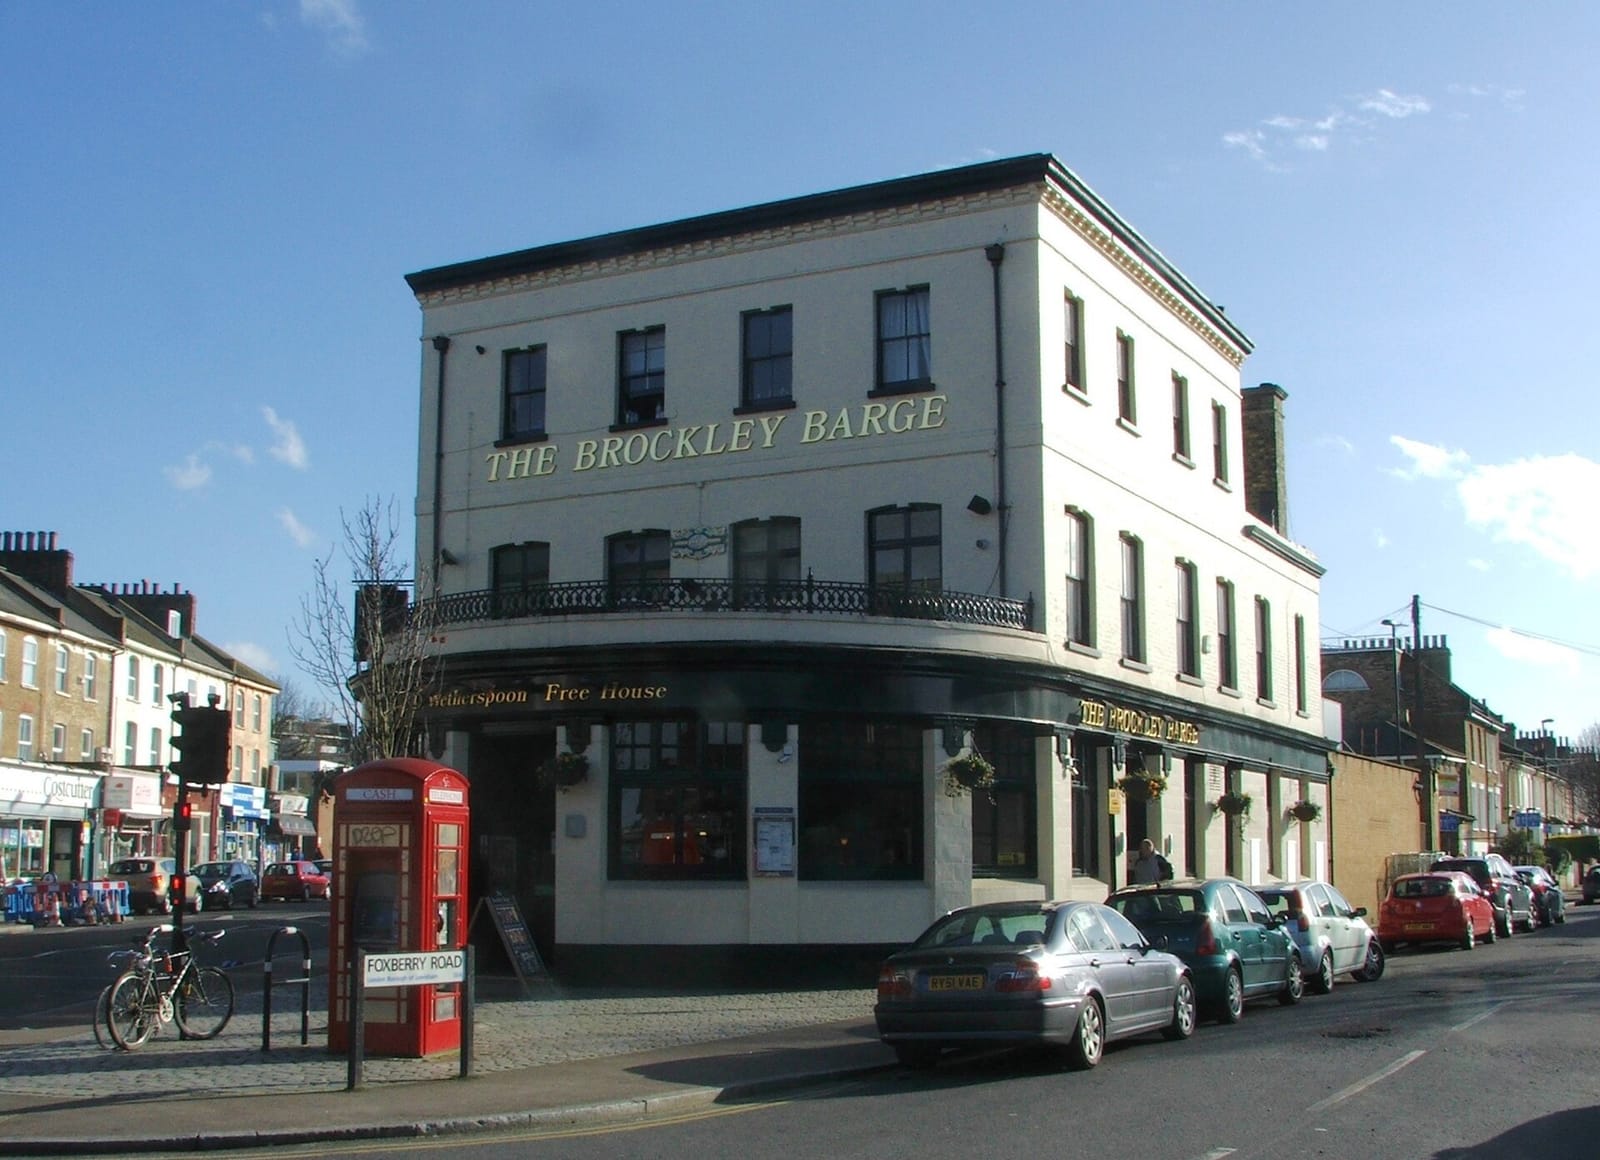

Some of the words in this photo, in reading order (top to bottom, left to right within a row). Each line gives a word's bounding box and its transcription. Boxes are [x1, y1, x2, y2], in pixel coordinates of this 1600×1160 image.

[485, 445, 559, 482] THE
[573, 415, 787, 472] BROCKLEY
[800, 394, 948, 444] BARGE
[544, 683, 590, 701] Free
[601, 681, 668, 700] House
[1079, 699, 1106, 727] THE
[1108, 706, 1165, 738] BROCKLEY
[1165, 719, 1199, 744] BARGE
[43, 776, 94, 802] Costcutter
[362, 789, 397, 800] CASH
[367, 956, 427, 972] FOXBERRY
[430, 955, 463, 969] ROAD
